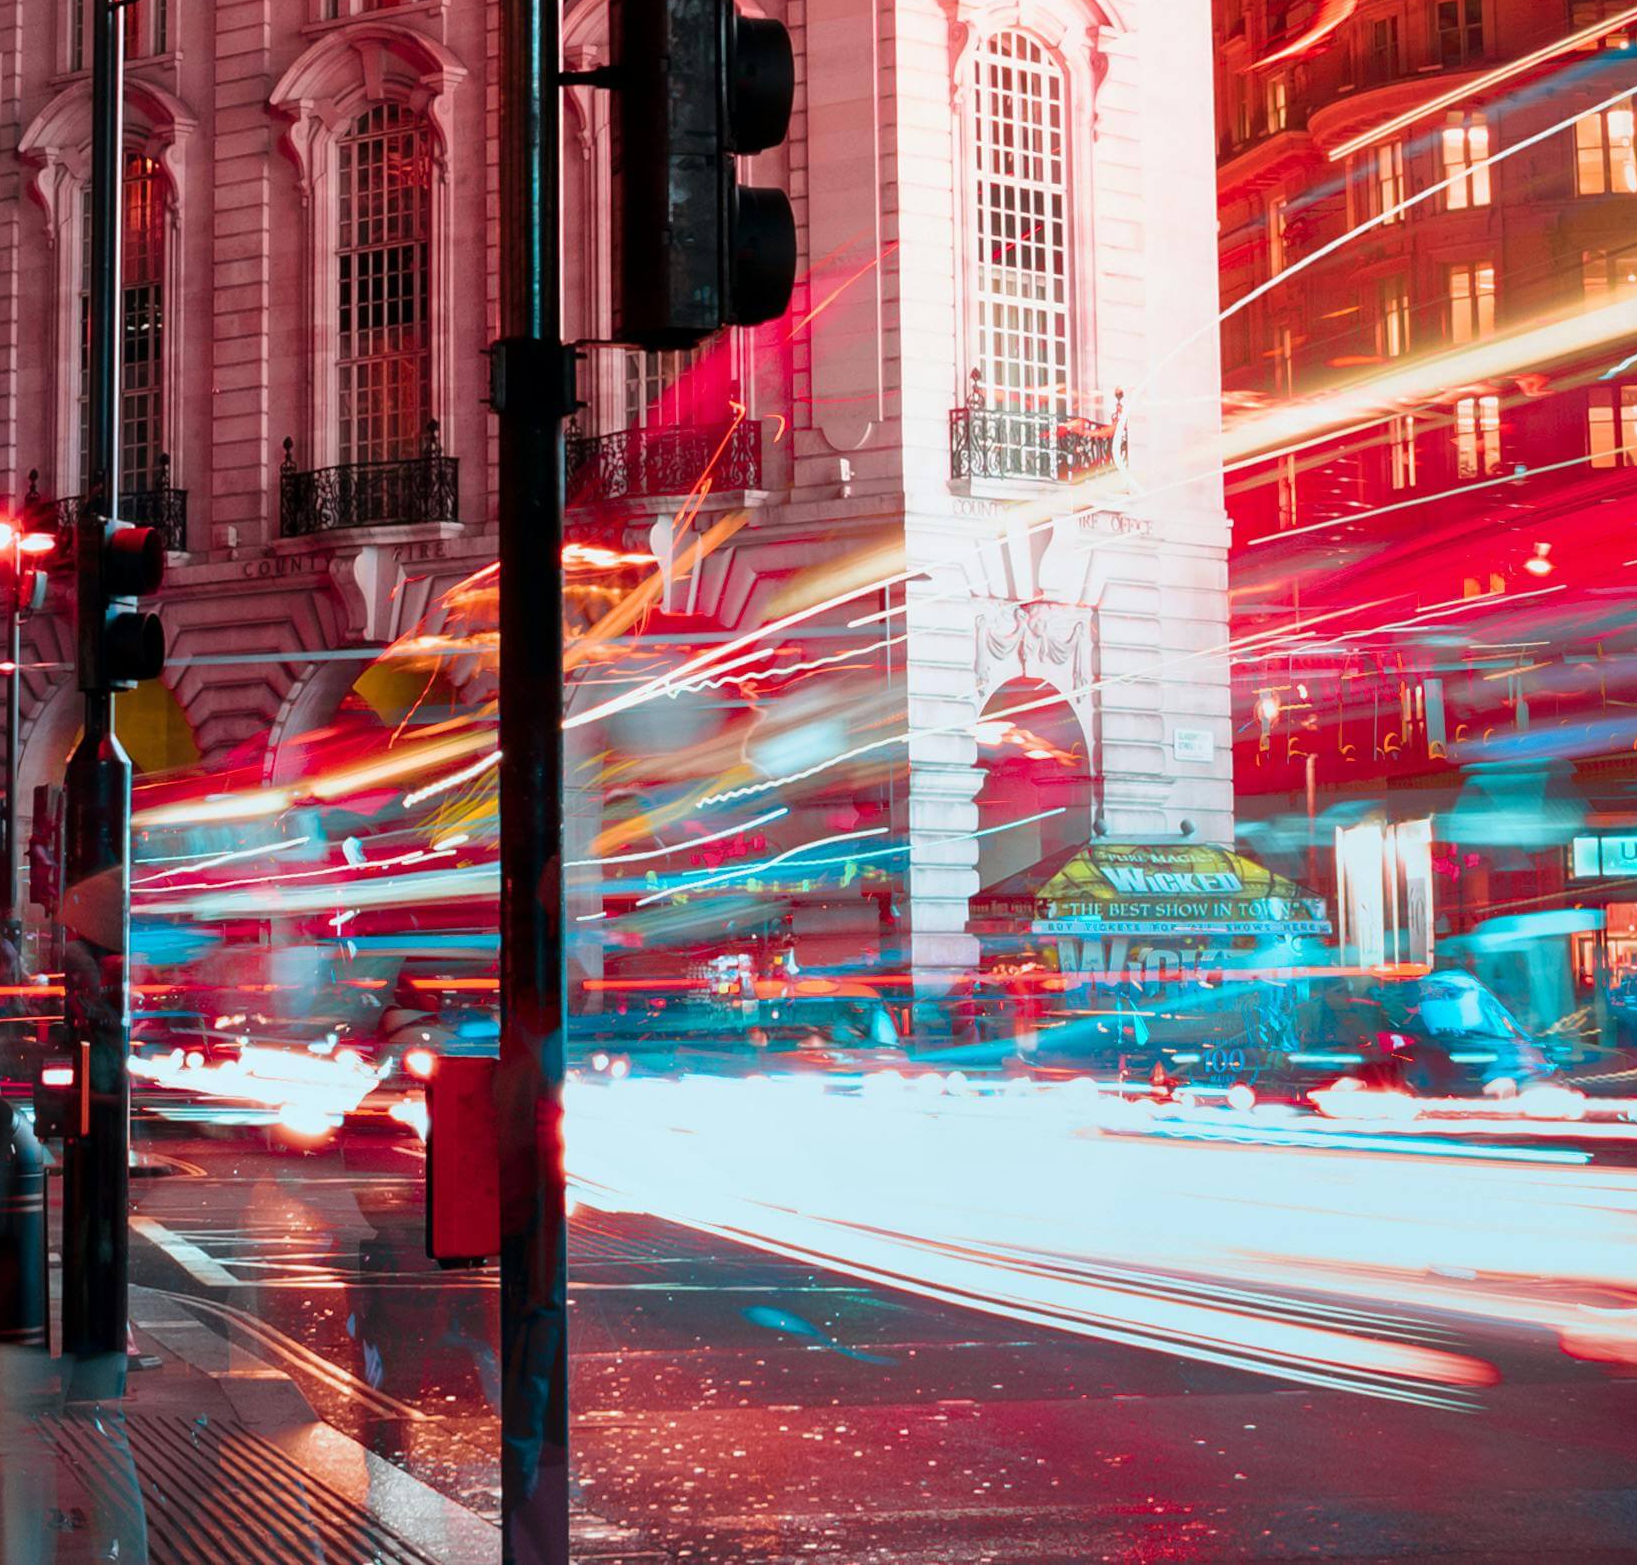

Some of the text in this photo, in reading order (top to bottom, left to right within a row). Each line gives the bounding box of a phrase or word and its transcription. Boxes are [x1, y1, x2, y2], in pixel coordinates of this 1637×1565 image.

[1110, 902, 1151, 917] BEST
[1155, 902, 1209, 917] SHOW
[1213, 902, 1233, 917] IN
